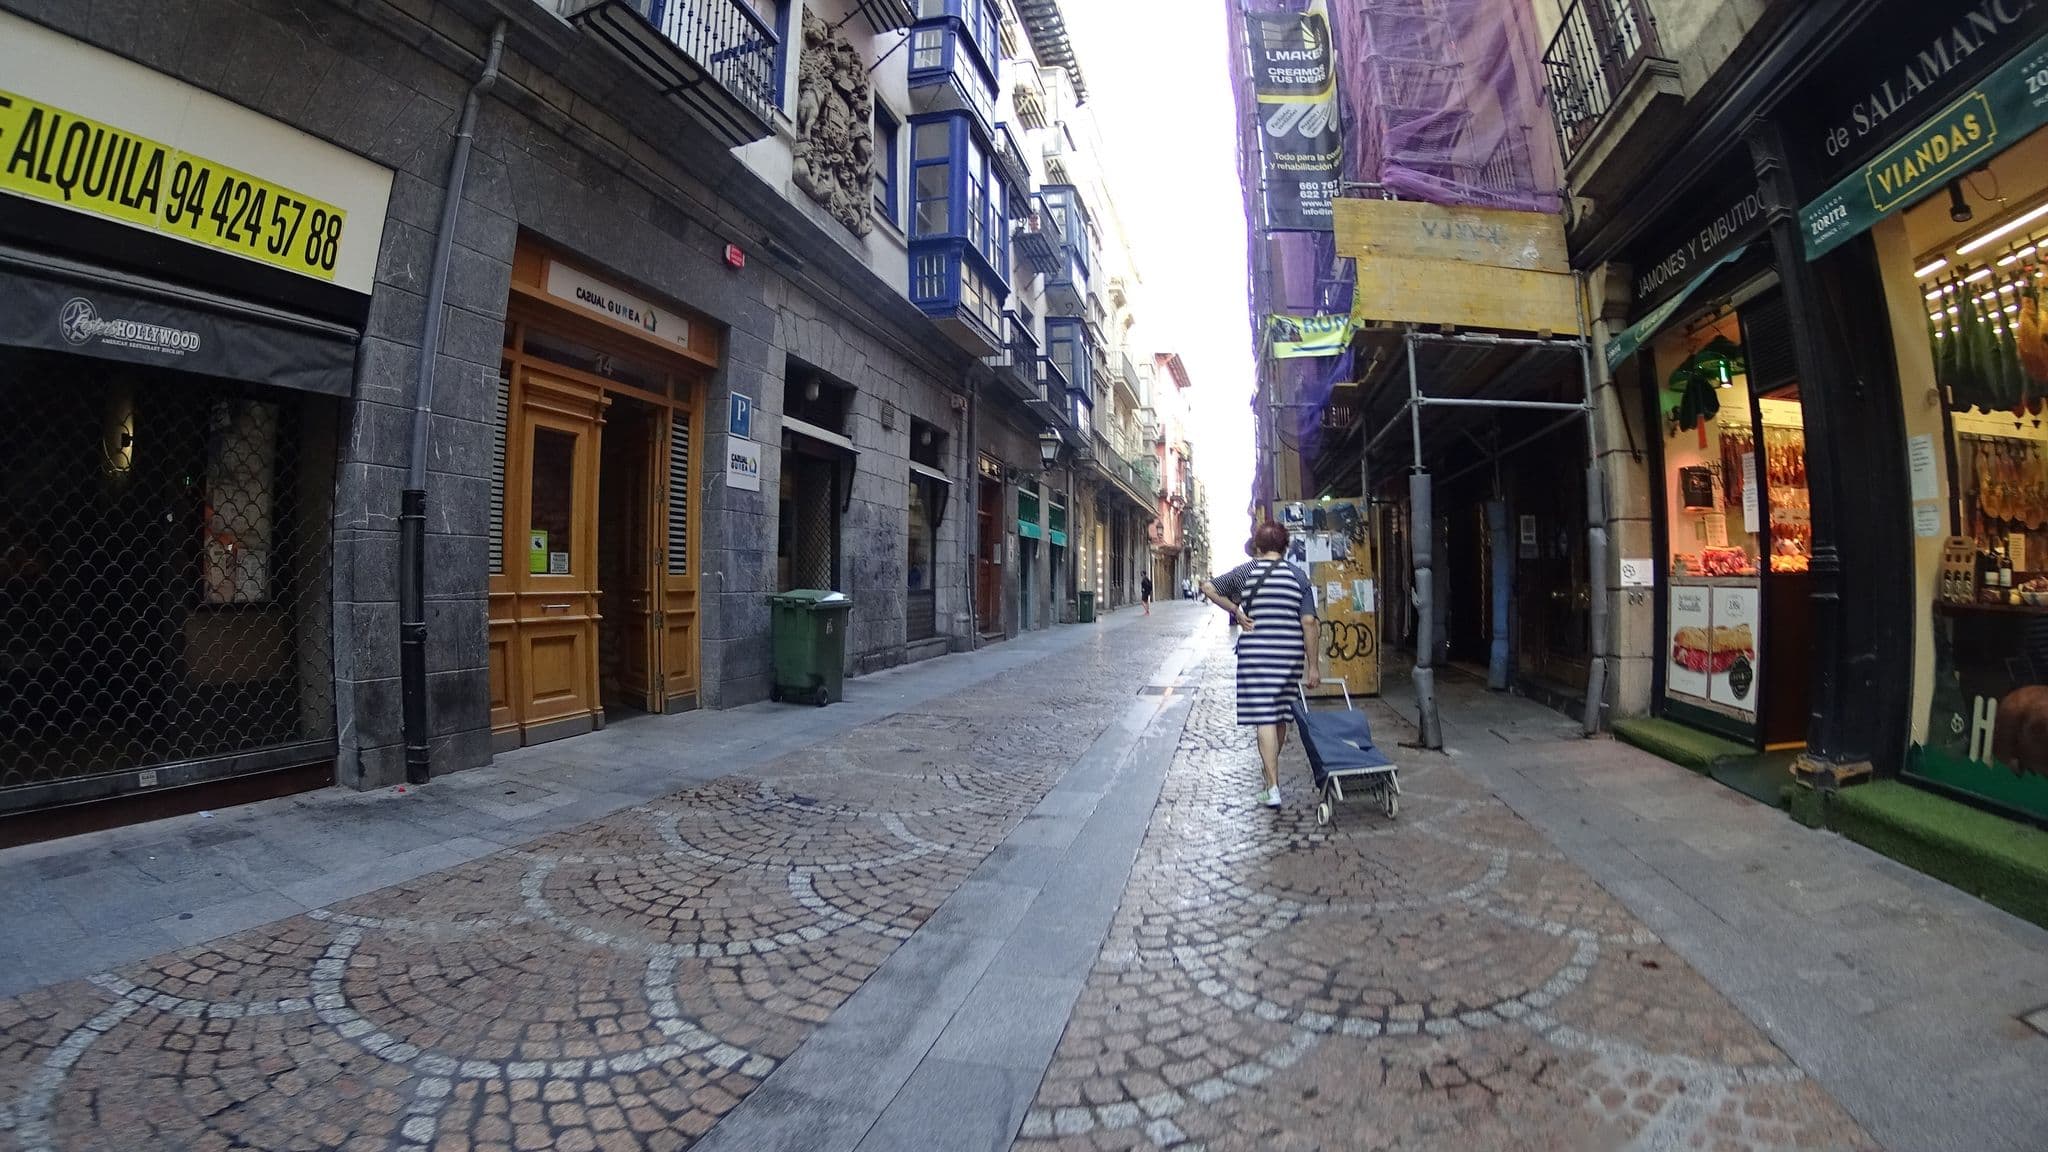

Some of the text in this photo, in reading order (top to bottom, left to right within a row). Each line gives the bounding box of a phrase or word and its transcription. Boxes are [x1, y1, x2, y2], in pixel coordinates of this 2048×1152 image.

[1269, 75, 1293, 83] TUS
[1825, 0, 2037, 157] de SALAMANC
[1270, 162, 1276, 170] y
[1277, 162, 1333, 171] rehabilitación
[1273, 152, 1295, 161] Todo
[1296, 154, 1315, 162] para
[1316, 153, 1326, 161] la
[1877, 112, 1982, 195] VIANDAS
[6, 106, 165, 215] ALQUILA
[165, 160, 211, 230] 94
[210, 175, 267, 248] 424
[267, 195, 307, 257] 57
[304, 208, 343, 271] 88
[1301, 200, 1332, 208] www.in
[1302, 208, 1333, 216] info@in
[1637, 249, 1687, 299] JAMONES
[1687, 238, 1697, 260] Y
[576, 286, 640, 323] CASUAL GUREA
[116, 319, 200, 351] HOLLYWOOD
[737, 399, 746, 421] P
